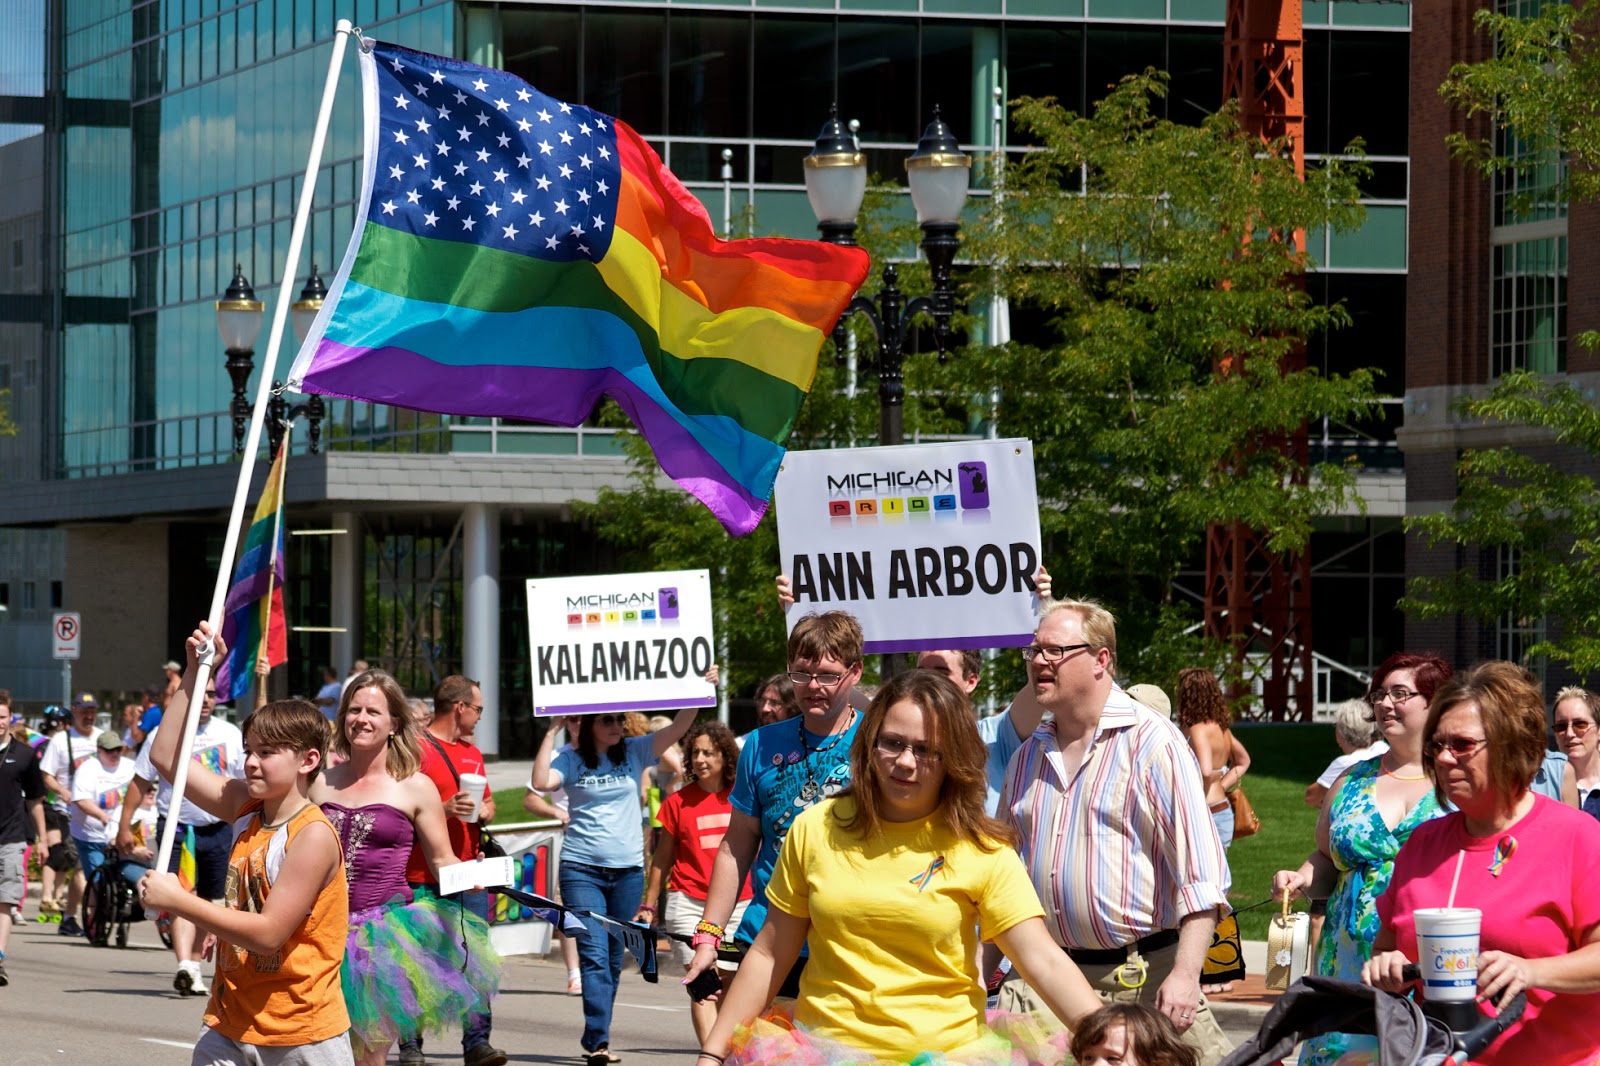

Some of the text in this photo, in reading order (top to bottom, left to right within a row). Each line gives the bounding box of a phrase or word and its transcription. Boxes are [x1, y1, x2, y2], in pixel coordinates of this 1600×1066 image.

[827, 469, 952, 489] MICHIGAN
[831, 496, 954, 515] PRIDE
[792, 542, 1037, 602] ANN ARBOR
[566, 592, 655, 607] MICHIGAN
[568, 610, 655, 623] PRIDE
[537, 636, 711, 686] KALAMAZOO
